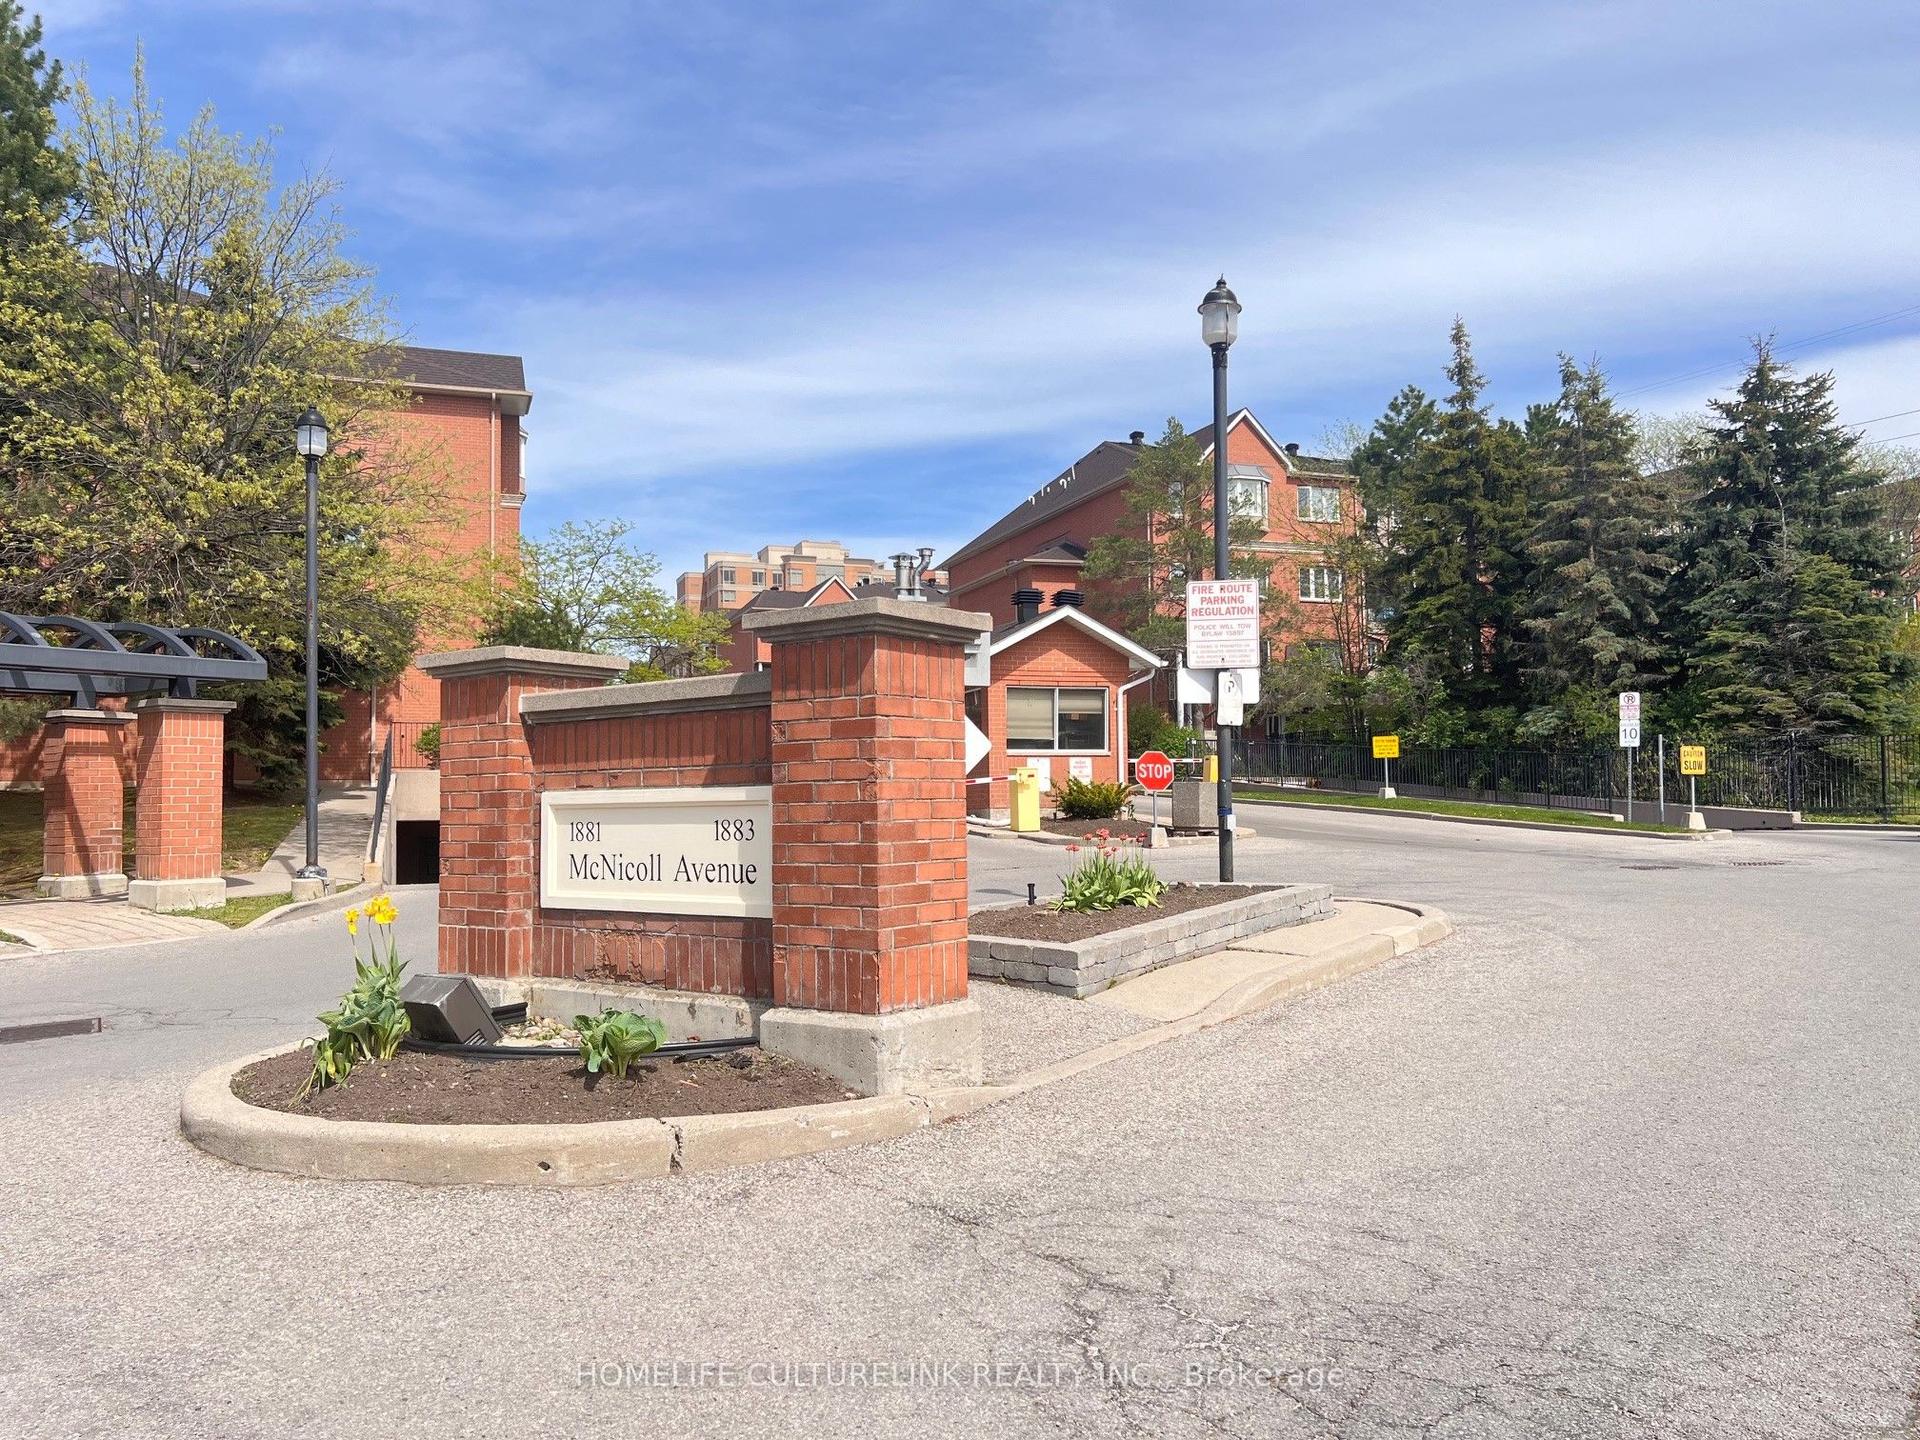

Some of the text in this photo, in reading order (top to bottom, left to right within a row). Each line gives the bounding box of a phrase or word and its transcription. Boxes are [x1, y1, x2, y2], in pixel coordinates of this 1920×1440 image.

[1191, 584, 1253, 595] FIRE ROUTE
[1200, 595, 1245, 605] PARKING
[1191, 606, 1254, 617] REGULATION
[1622, 727, 1638, 739] 10
[1138, 763, 1172, 779] STOP
[1684, 760, 1703, 771] SLOW
[569, 818, 755, 842] 1881 1883
[569, 853, 758, 885] McNicoll Avenue
